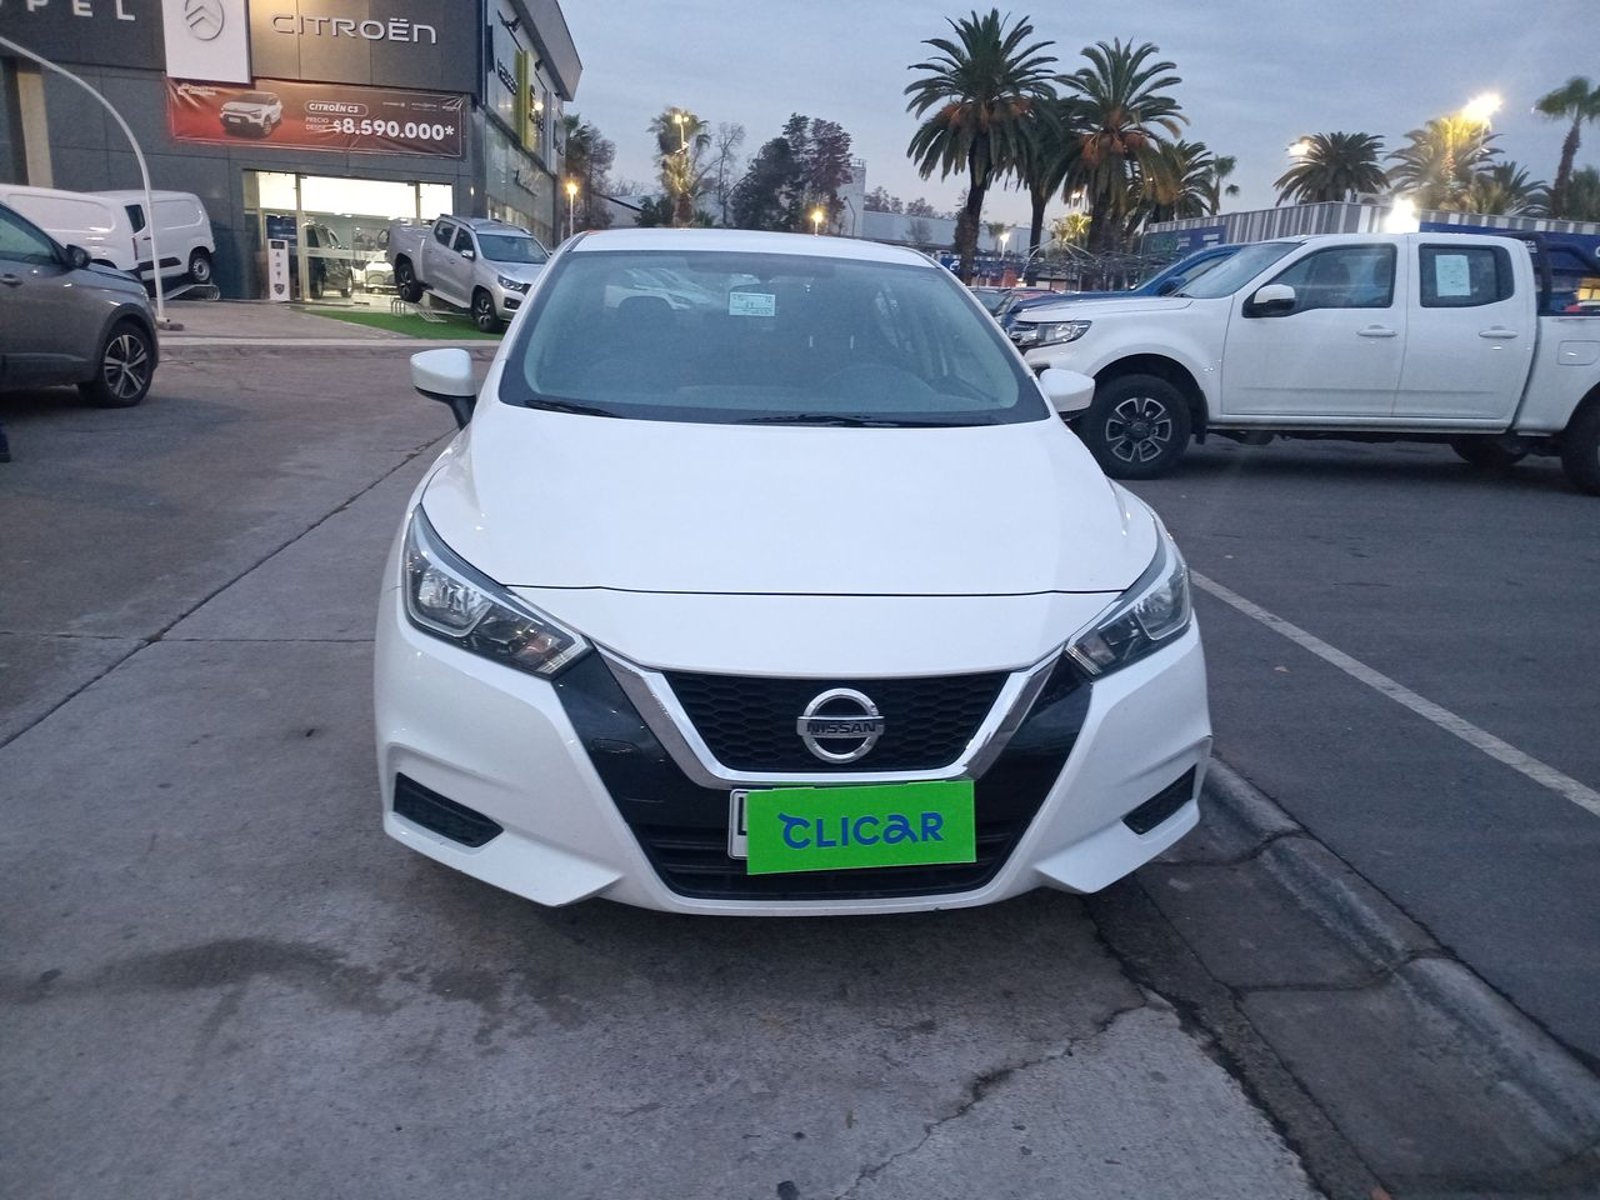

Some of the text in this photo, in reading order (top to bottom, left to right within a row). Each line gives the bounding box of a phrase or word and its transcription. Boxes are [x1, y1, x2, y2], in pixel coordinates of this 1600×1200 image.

[271, 14, 437, 44] CITROËN
[347, 105, 359, 113] C3
[806, 721, 877, 734] NISSAN
[777, 811, 945, 850] CLICAR
